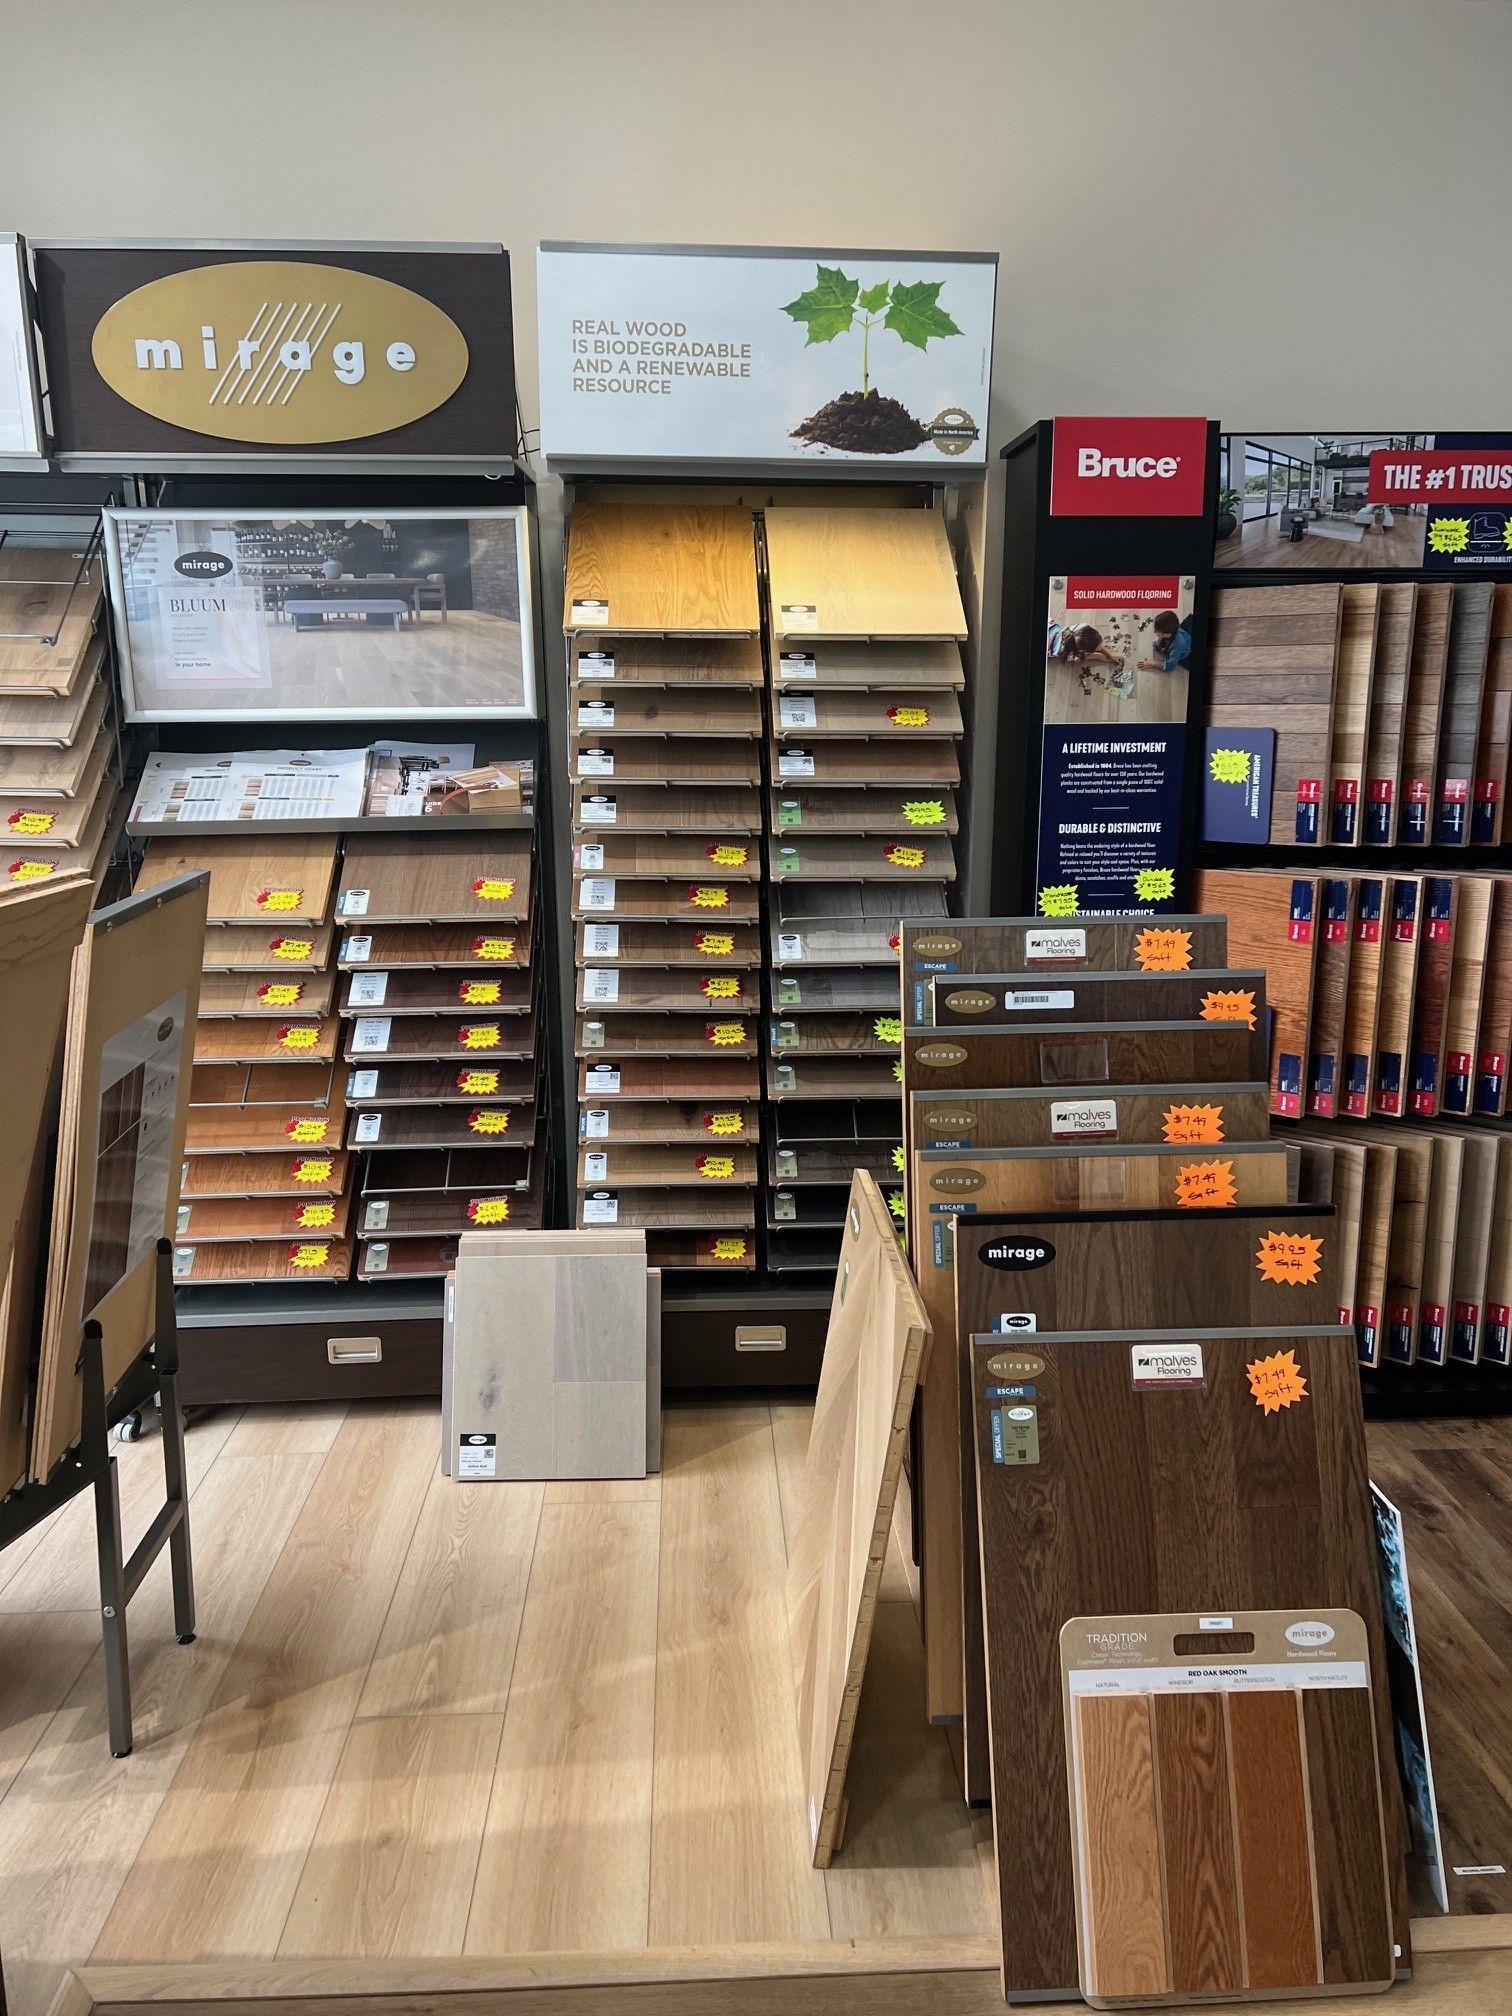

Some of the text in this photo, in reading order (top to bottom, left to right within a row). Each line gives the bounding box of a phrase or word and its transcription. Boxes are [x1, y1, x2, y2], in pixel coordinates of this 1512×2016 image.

[572, 319, 687, 338] REAL WOOD
[572, 338, 751, 359] IS BIODEGRADABLE
[134, 325, 416, 385] mirage
[572, 358, 751, 378] AND A RENEWABLE
[573, 377, 672, 395] RESOURCE
[1077, 447, 1178, 479] Bruce
[1384, 464, 1421, 490] THE
[1425, 464, 1456, 490] #1
[182, 559, 225, 572] mirage
[1454, 556, 1483, 564] ENHANCED
[1073, 587, 1173, 600] SOLID HARDWOOD FLOORING
[170, 598, 226, 612] BLUUM
[1062, 741, 1168, 754] A LIFETIME INVESTMENT
[1250, 754, 1262, 818] AMERICAN TREASURES
[1058, 822, 1162, 834] DURABLE & DISTINCTIVE
[918, 942, 957, 951] mirage
[1041, 936, 1081, 948] malves
[1046, 946, 1076, 956] Flooring
[951, 998, 990, 1007] mirage
[921, 1050, 962, 1060] mirage
[929, 1116, 972, 1126] mirage
[1067, 1109, 1111, 1122] malves
[1074, 1120, 1106, 1130] Flooring
[935, 1141, 960, 1149] ESCAPE
[935, 1176, 979, 1187] mirage
[939, 1204, 965, 1212] ESCAPE
[988, 1245, 1045, 1262] mirage
[993, 1361, 1038, 1371] mirage
[1149, 1354, 1197, 1368] malves
[1157, 1366, 1192, 1377] Flooring
[997, 1387, 1024, 1396] ESCAPE
[993, 1414, 1003, 1460] SPECIAL OFFER
[1086, 1632, 1148, 1644] TRADITION
[1291, 1628, 1328, 1639] mirage
[1100, 1643, 1134, 1651] GRADE
[1286, 1649, 1316, 1658] Hardwood
[1188, 1668, 1248, 1678] RED OAK SMOOTH
